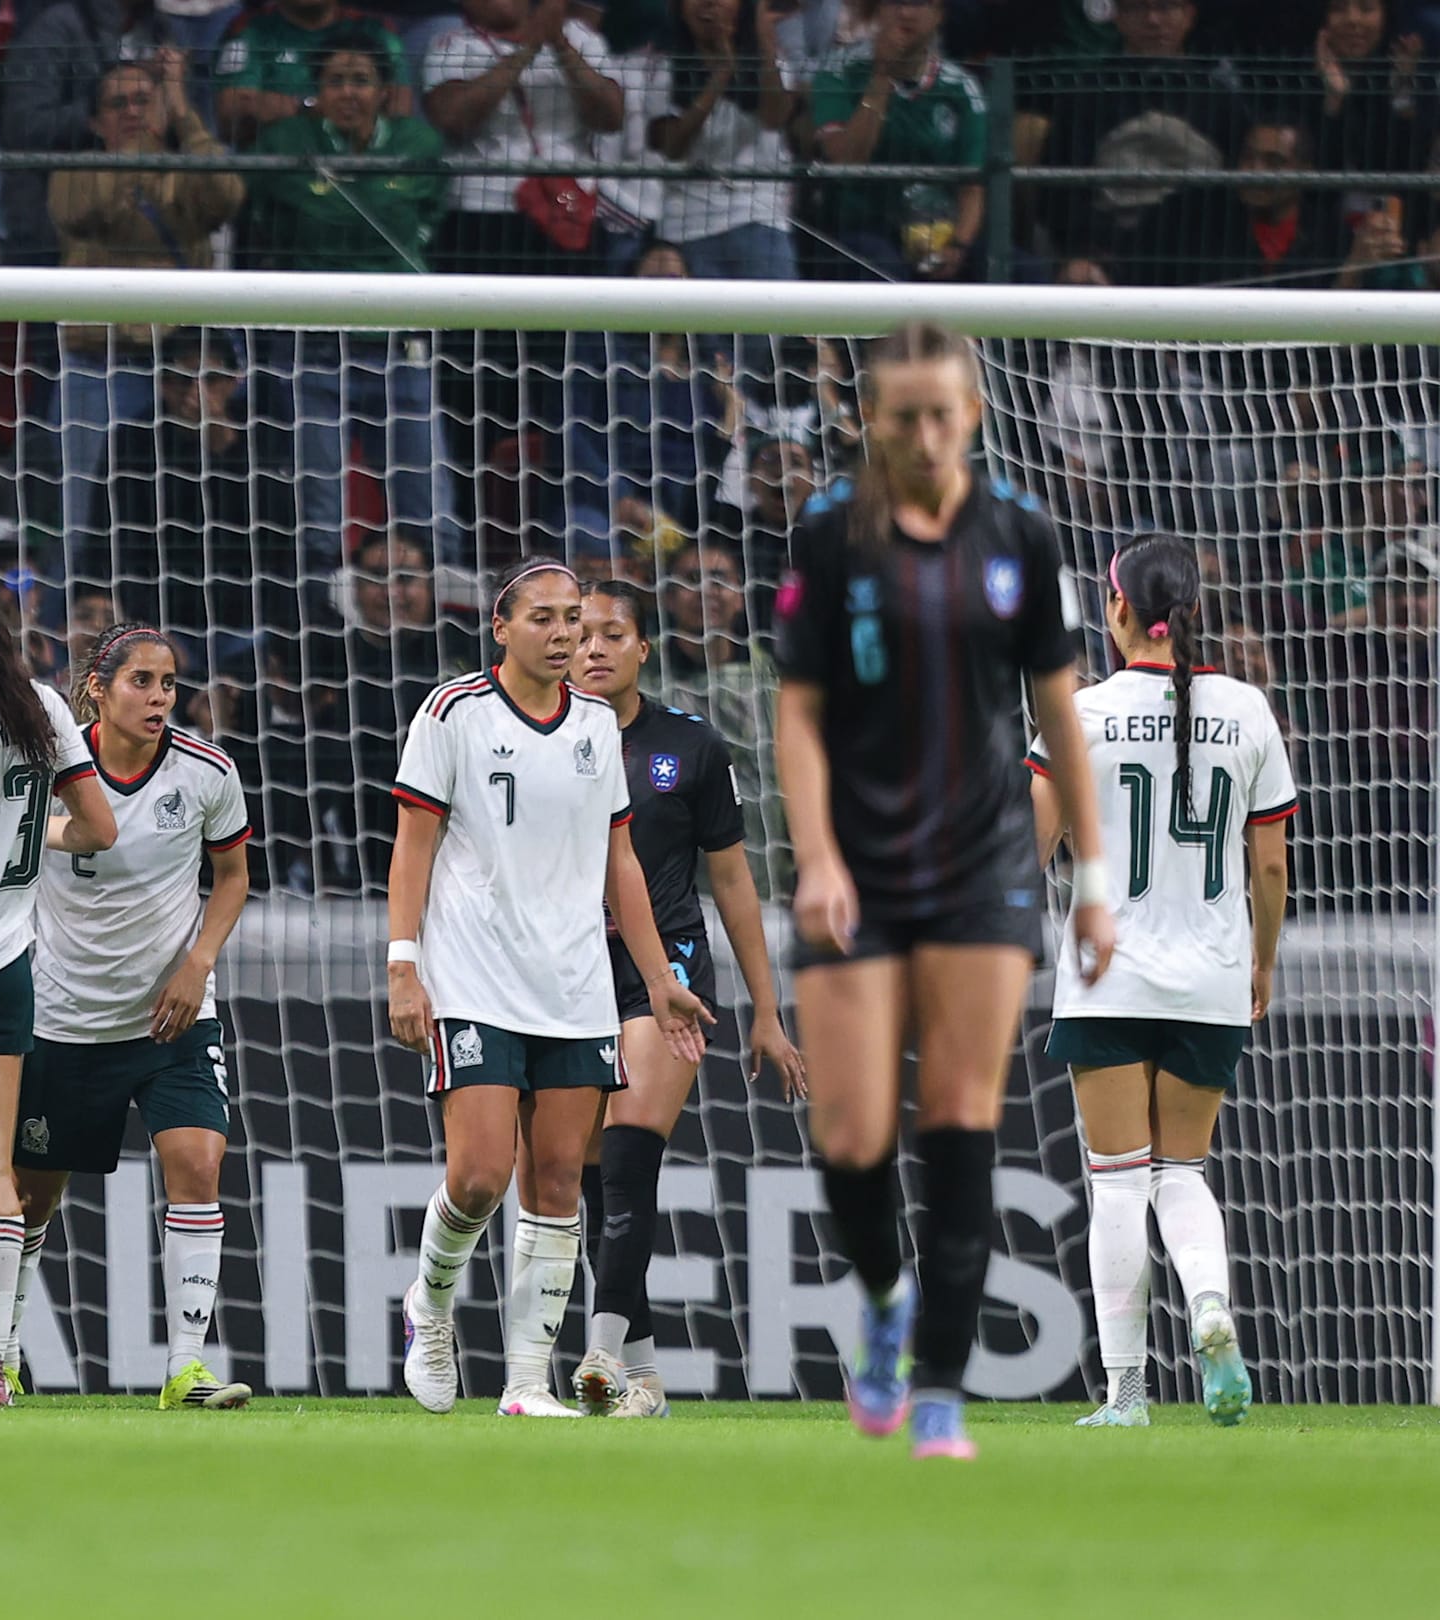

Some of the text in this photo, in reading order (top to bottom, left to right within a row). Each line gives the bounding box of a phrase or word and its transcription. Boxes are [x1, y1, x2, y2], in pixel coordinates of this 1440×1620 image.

[1104, 715, 1240, 747] G.ESPIOZA
[489, 772, 515, 826] 7
[1119, 763, 1234, 905] 14
